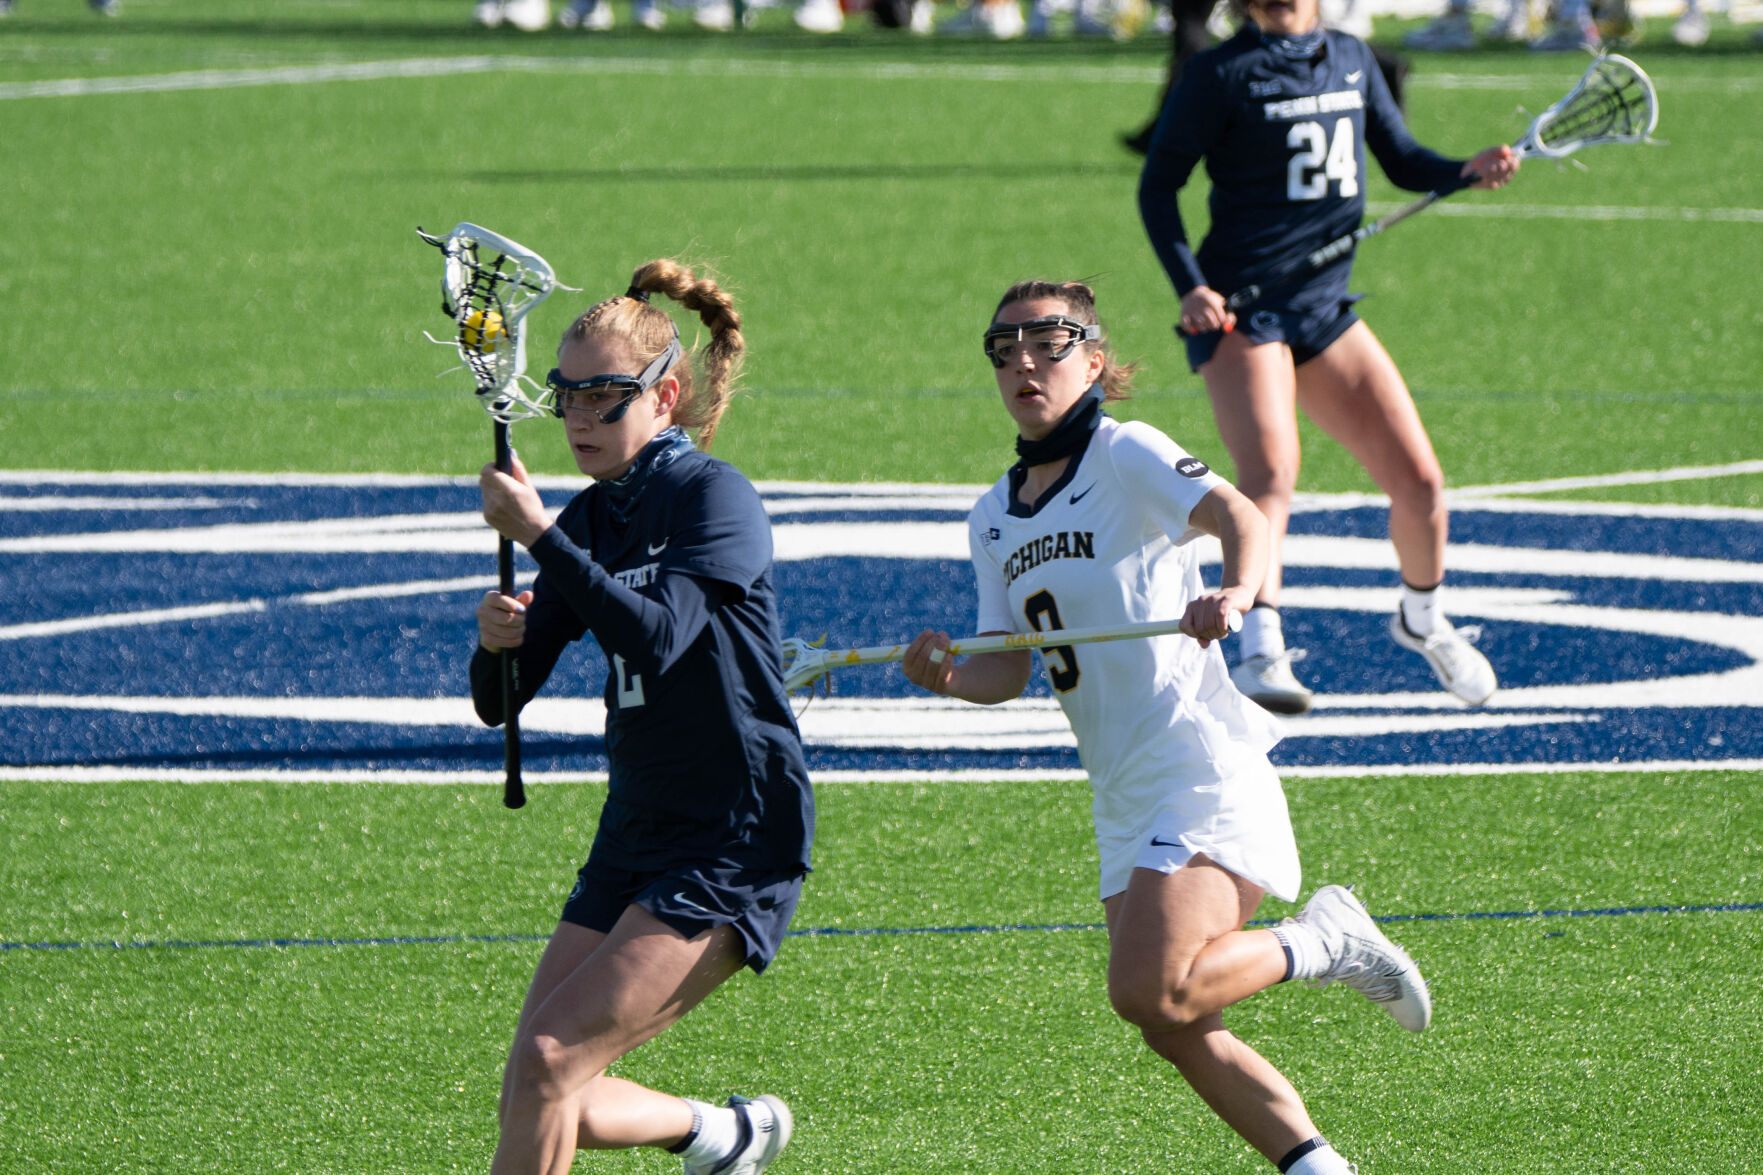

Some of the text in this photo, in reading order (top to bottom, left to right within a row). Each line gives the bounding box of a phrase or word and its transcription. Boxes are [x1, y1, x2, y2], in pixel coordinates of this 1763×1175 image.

[1263, 96, 1317, 120] PENN
[1287, 117, 1359, 200] 24
[1180, 461, 1206, 474] BLM
[1025, 589, 1080, 693] 9
